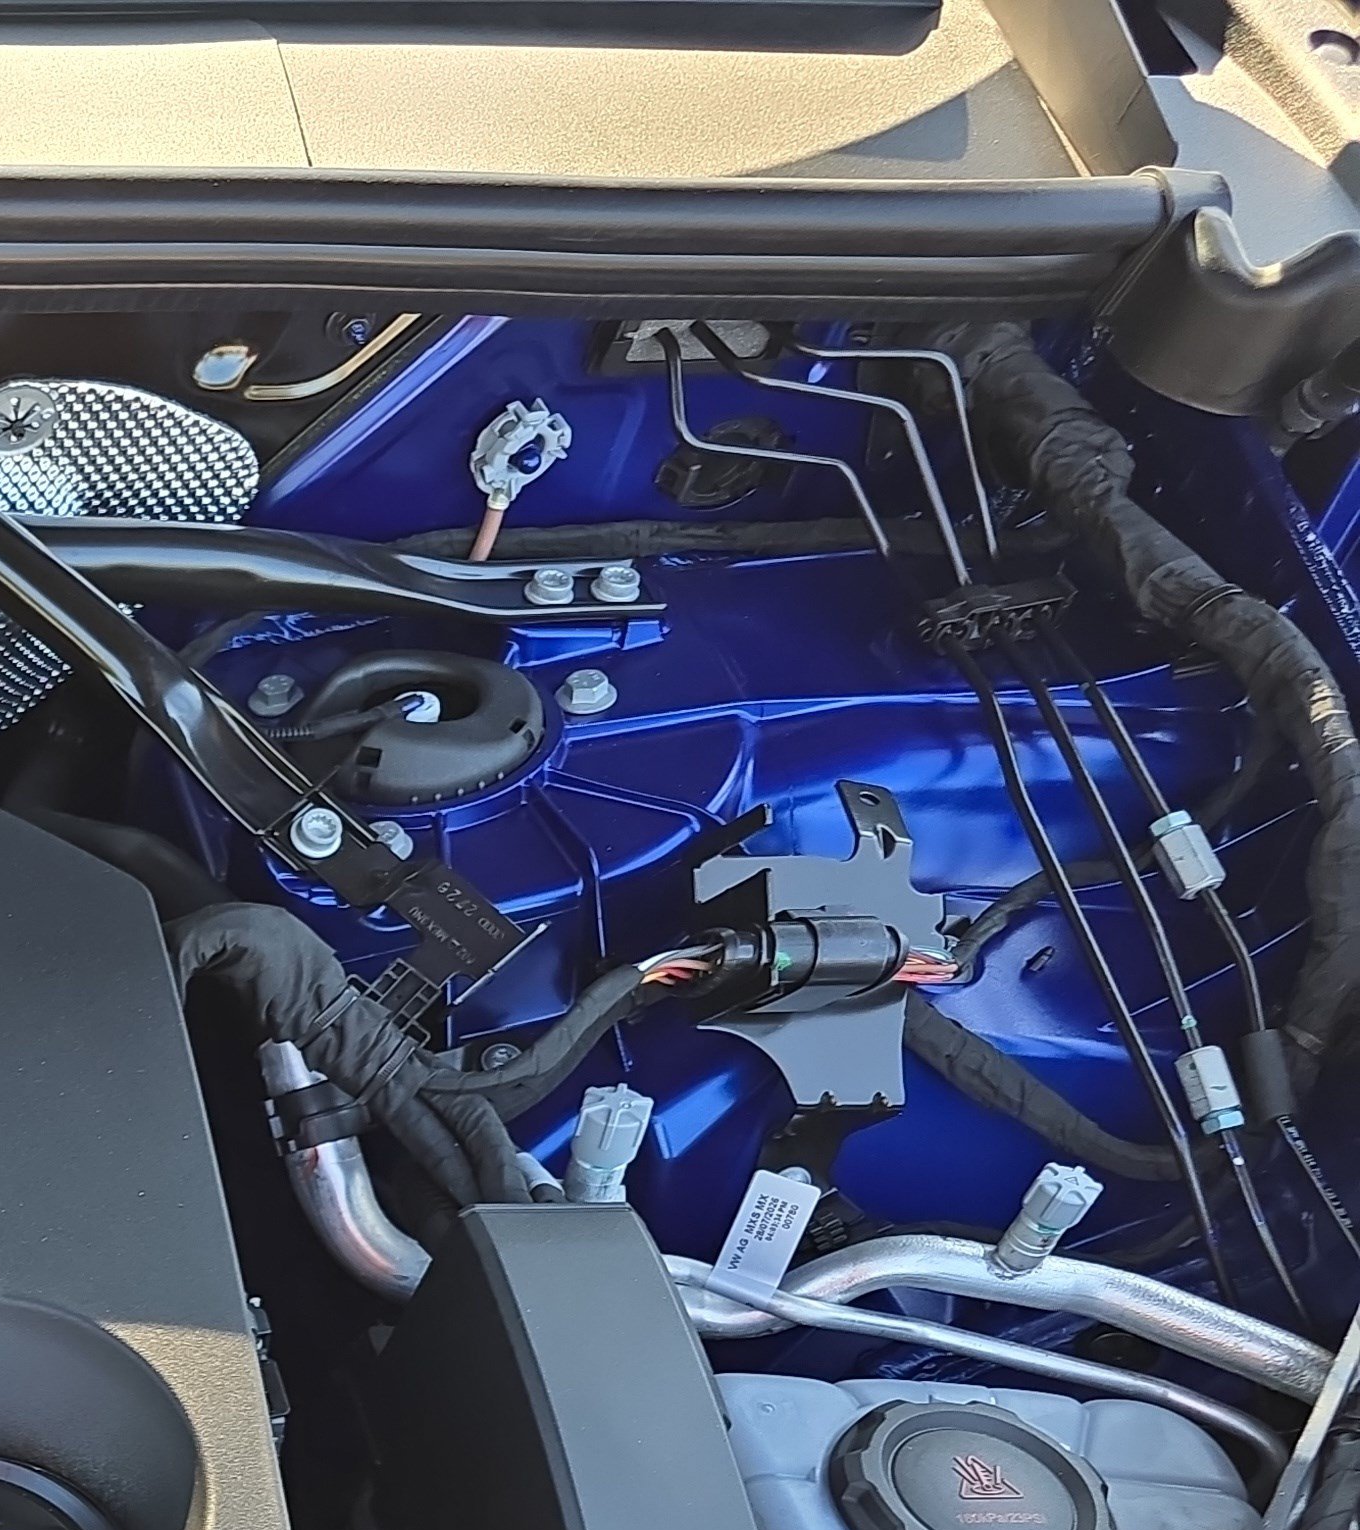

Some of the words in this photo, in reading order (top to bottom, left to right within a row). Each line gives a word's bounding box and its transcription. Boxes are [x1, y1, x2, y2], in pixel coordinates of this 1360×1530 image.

[728, 1253, 742, 1270] VW
[736, 1238, 749, 1253] AG
[755, 1194, 769, 1211] MX
